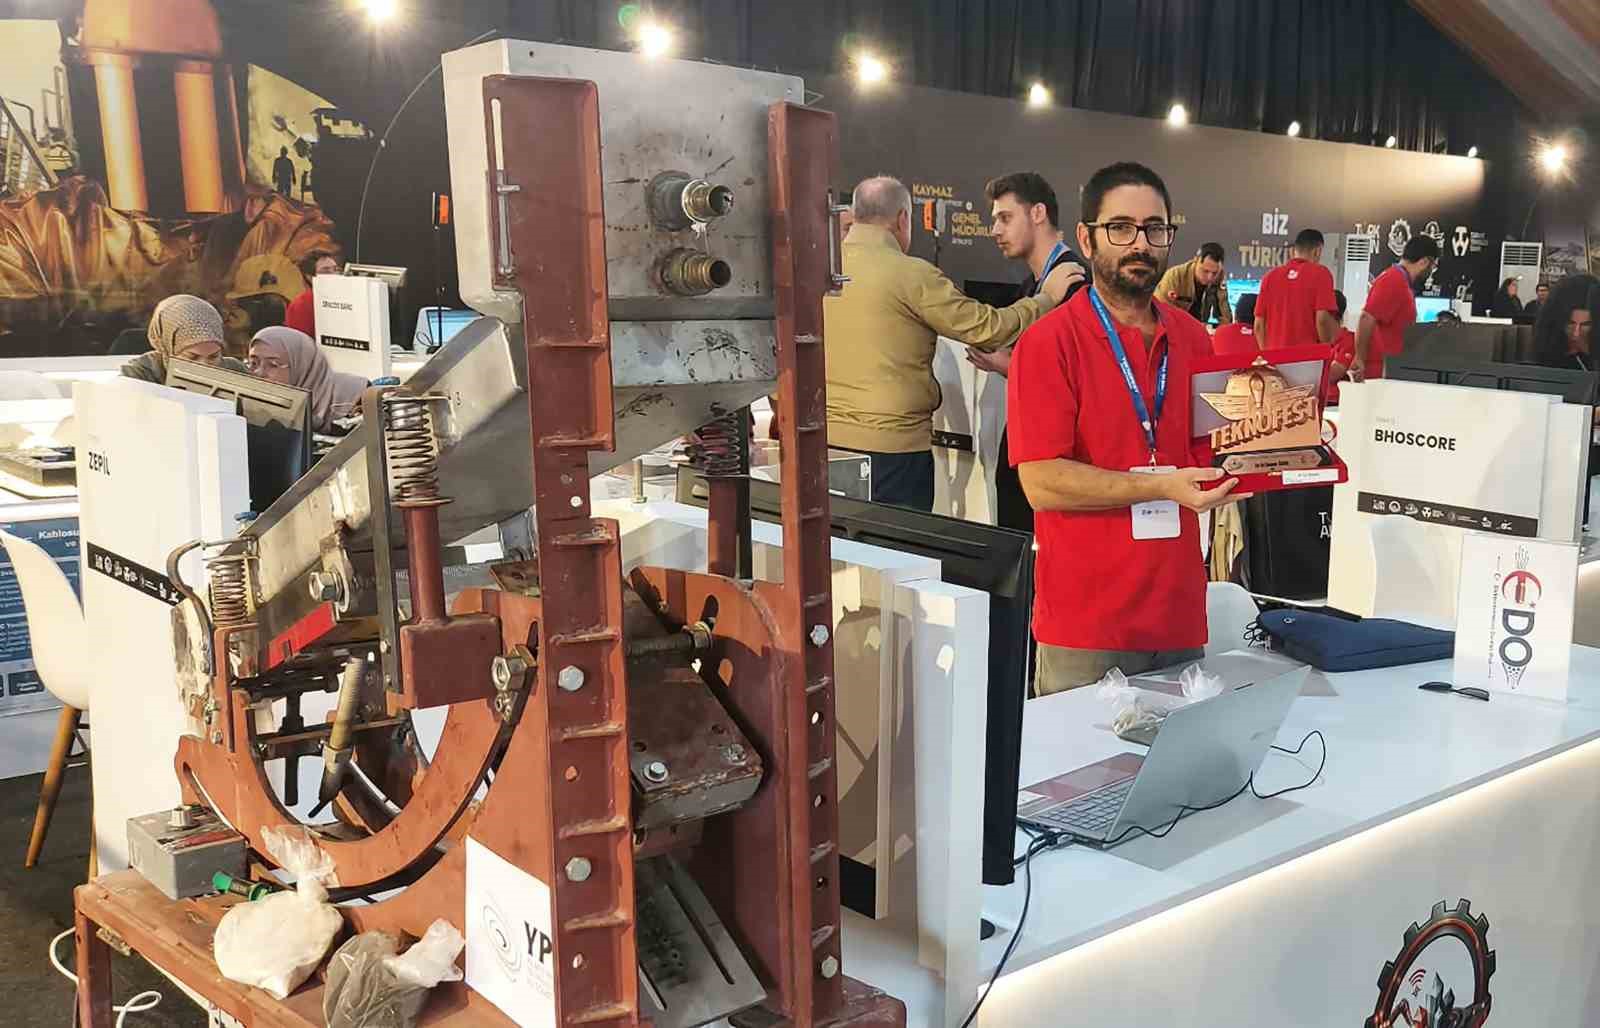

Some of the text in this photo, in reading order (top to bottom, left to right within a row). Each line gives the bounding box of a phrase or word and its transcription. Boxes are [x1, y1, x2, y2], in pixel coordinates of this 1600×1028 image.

[1262, 207, 1289, 235] BİZ
[1208, 397, 1319, 449] TEKNOFEST
[1374, 428, 1456, 452] BHOSCORE
[88, 450, 111, 476] ZEPİL
